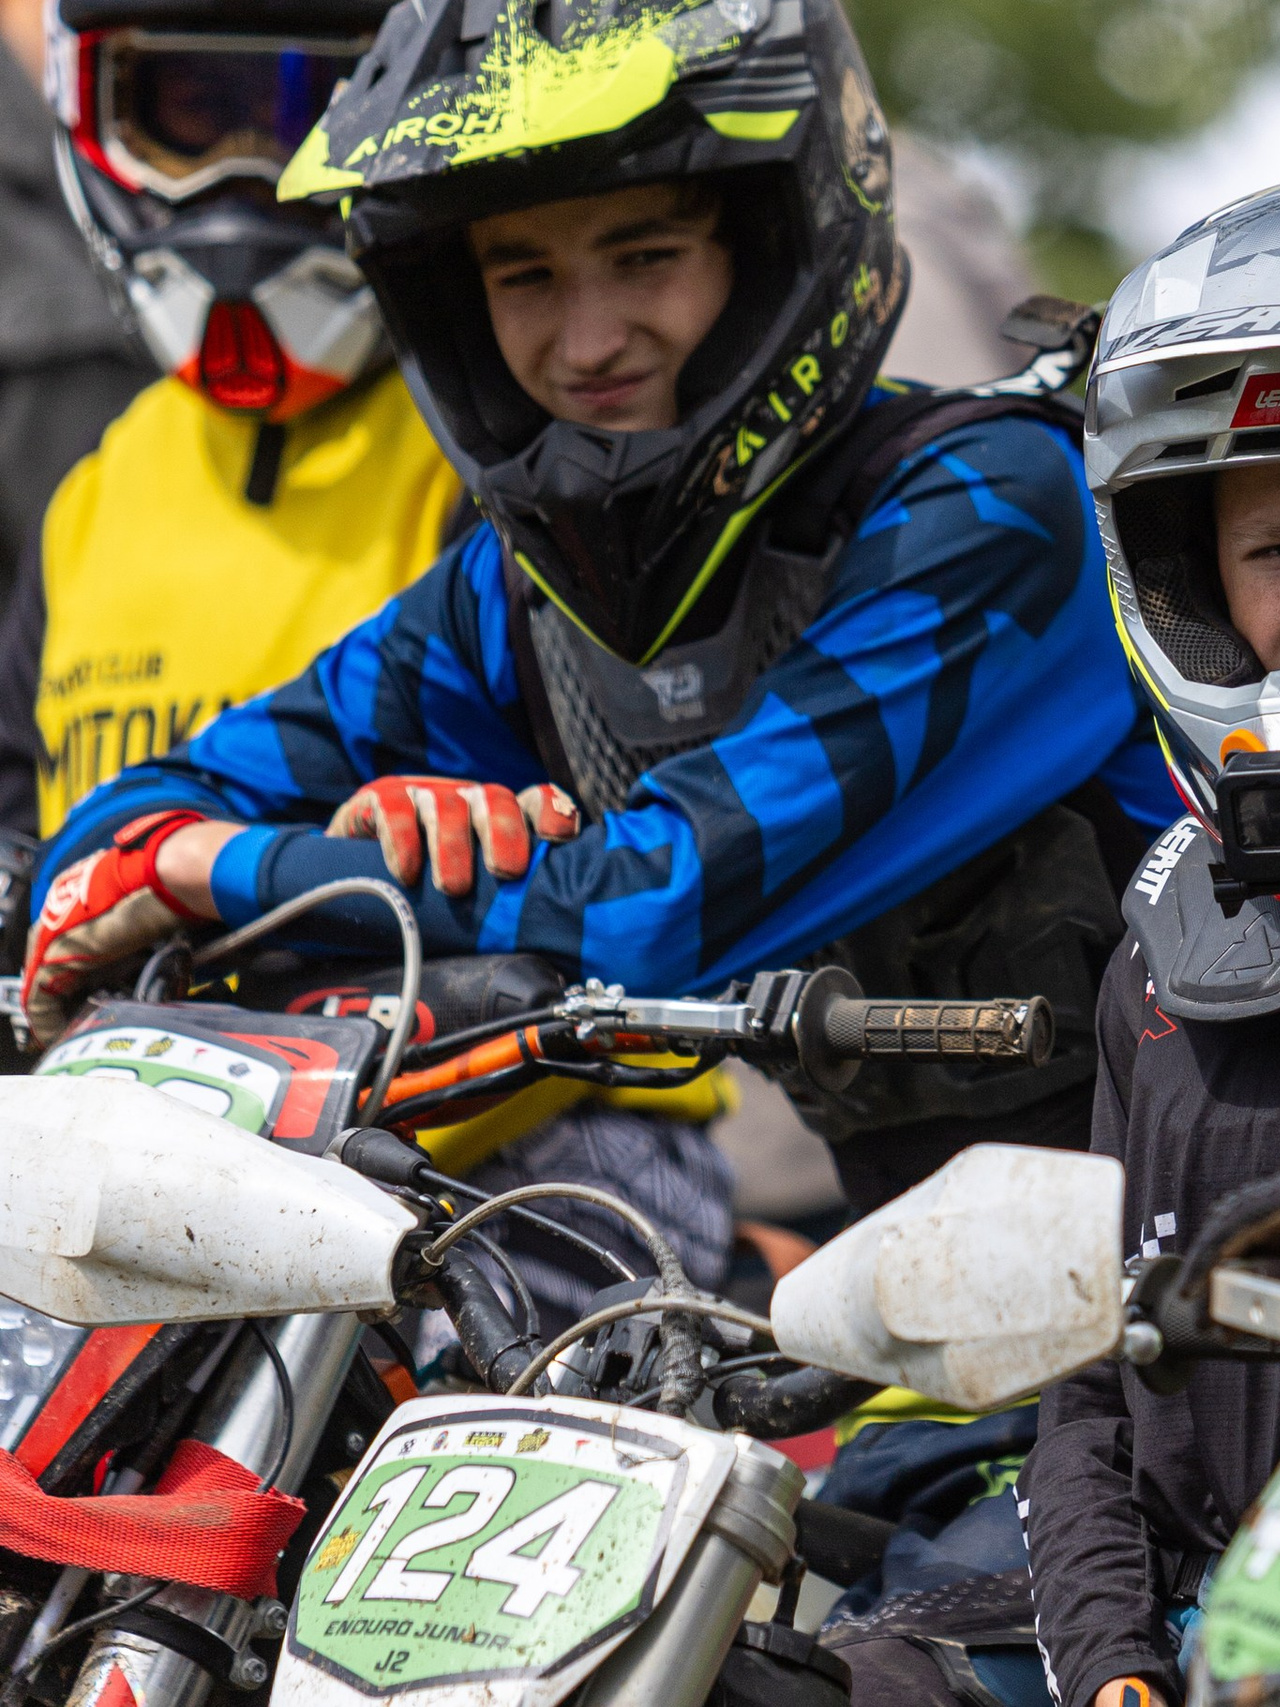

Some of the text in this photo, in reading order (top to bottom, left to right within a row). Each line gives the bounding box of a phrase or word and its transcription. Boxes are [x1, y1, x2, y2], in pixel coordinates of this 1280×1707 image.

[736, 263, 871, 468] AIROH
[323, 1465, 622, 1619] 124
[324, 1618, 511, 1651] ENDURO JUNOR
[374, 1650, 410, 1673] J2
